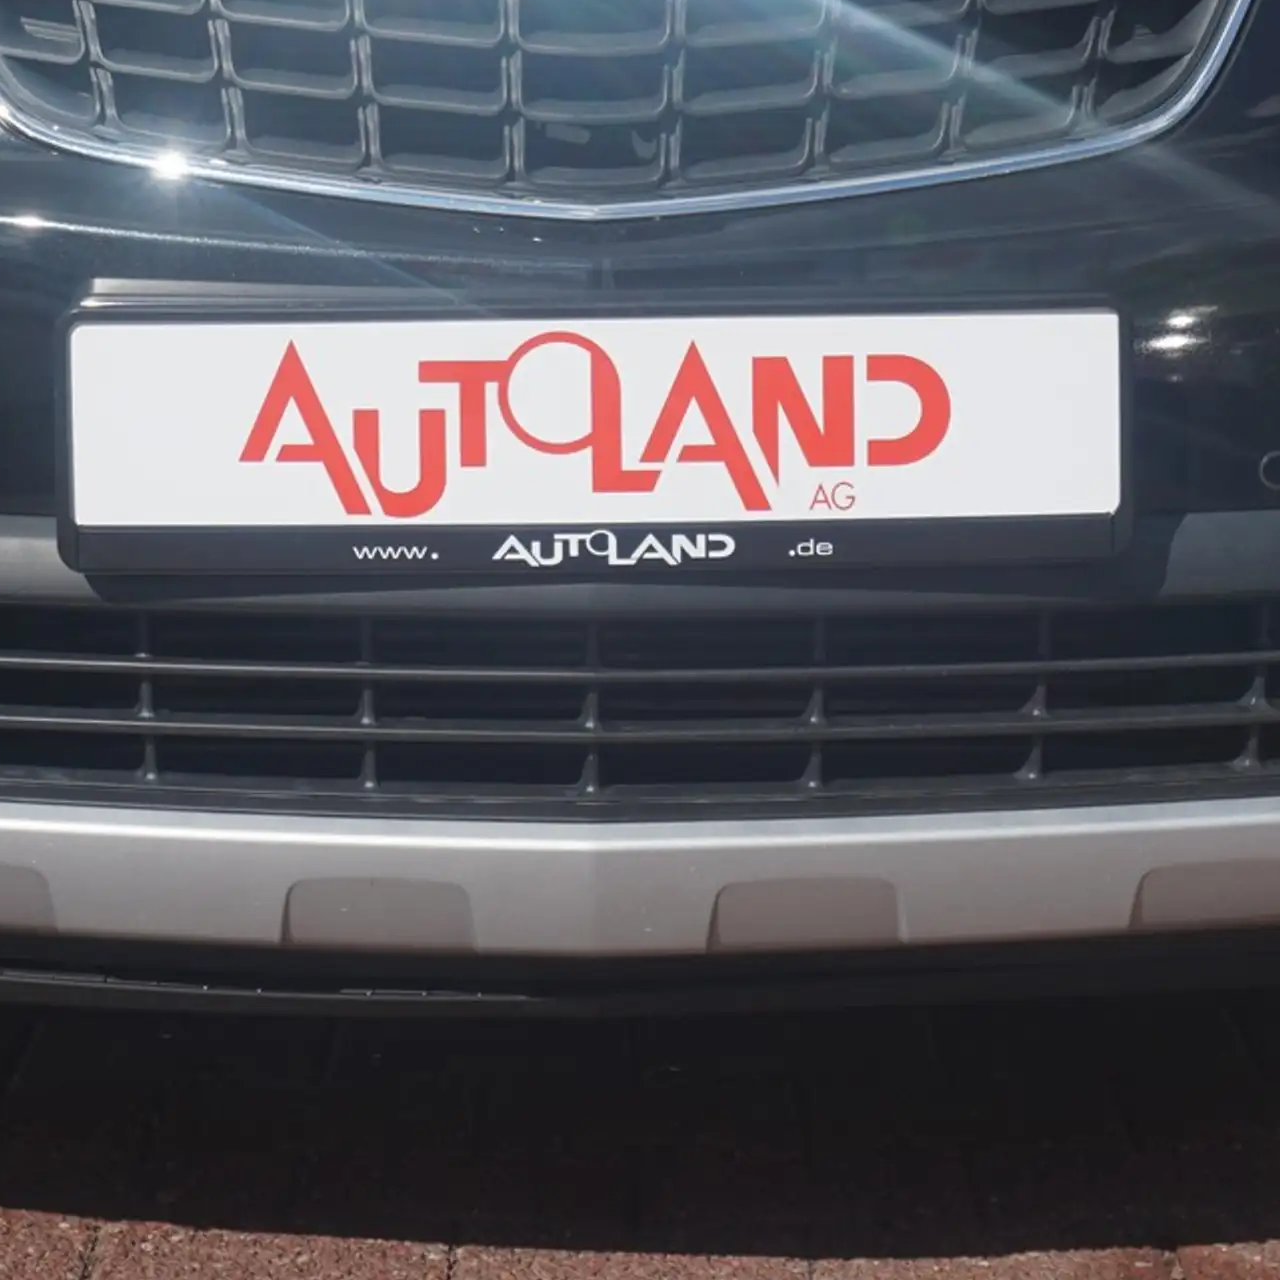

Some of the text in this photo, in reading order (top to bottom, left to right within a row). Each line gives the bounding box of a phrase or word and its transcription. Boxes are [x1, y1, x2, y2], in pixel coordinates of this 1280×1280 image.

[239, 330, 952, 517] AUTOLAND
[809, 481, 856, 511] AG
[352, 528, 834, 568] www. AUTOLAND .de
